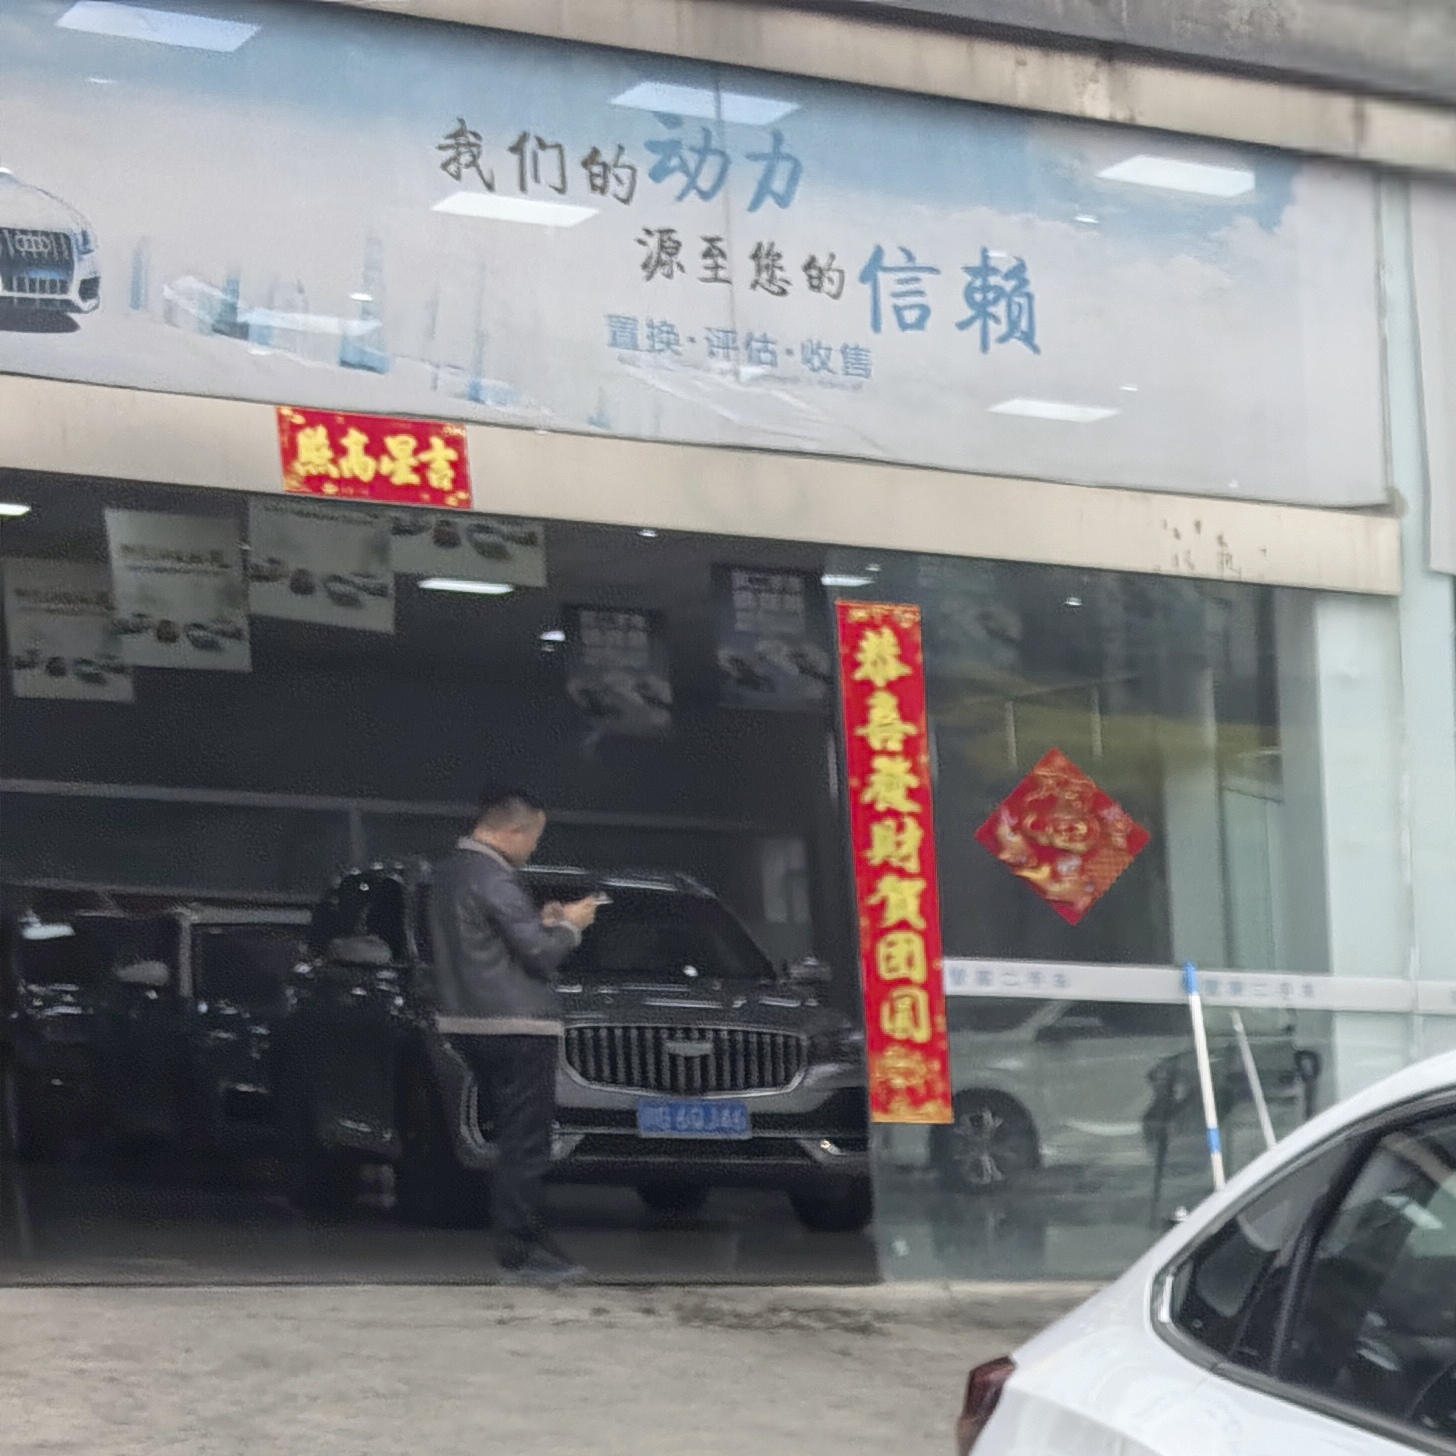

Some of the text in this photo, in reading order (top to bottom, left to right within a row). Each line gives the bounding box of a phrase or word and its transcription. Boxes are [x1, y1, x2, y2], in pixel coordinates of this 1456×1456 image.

[435, 113, 803, 213] 我们的动力
